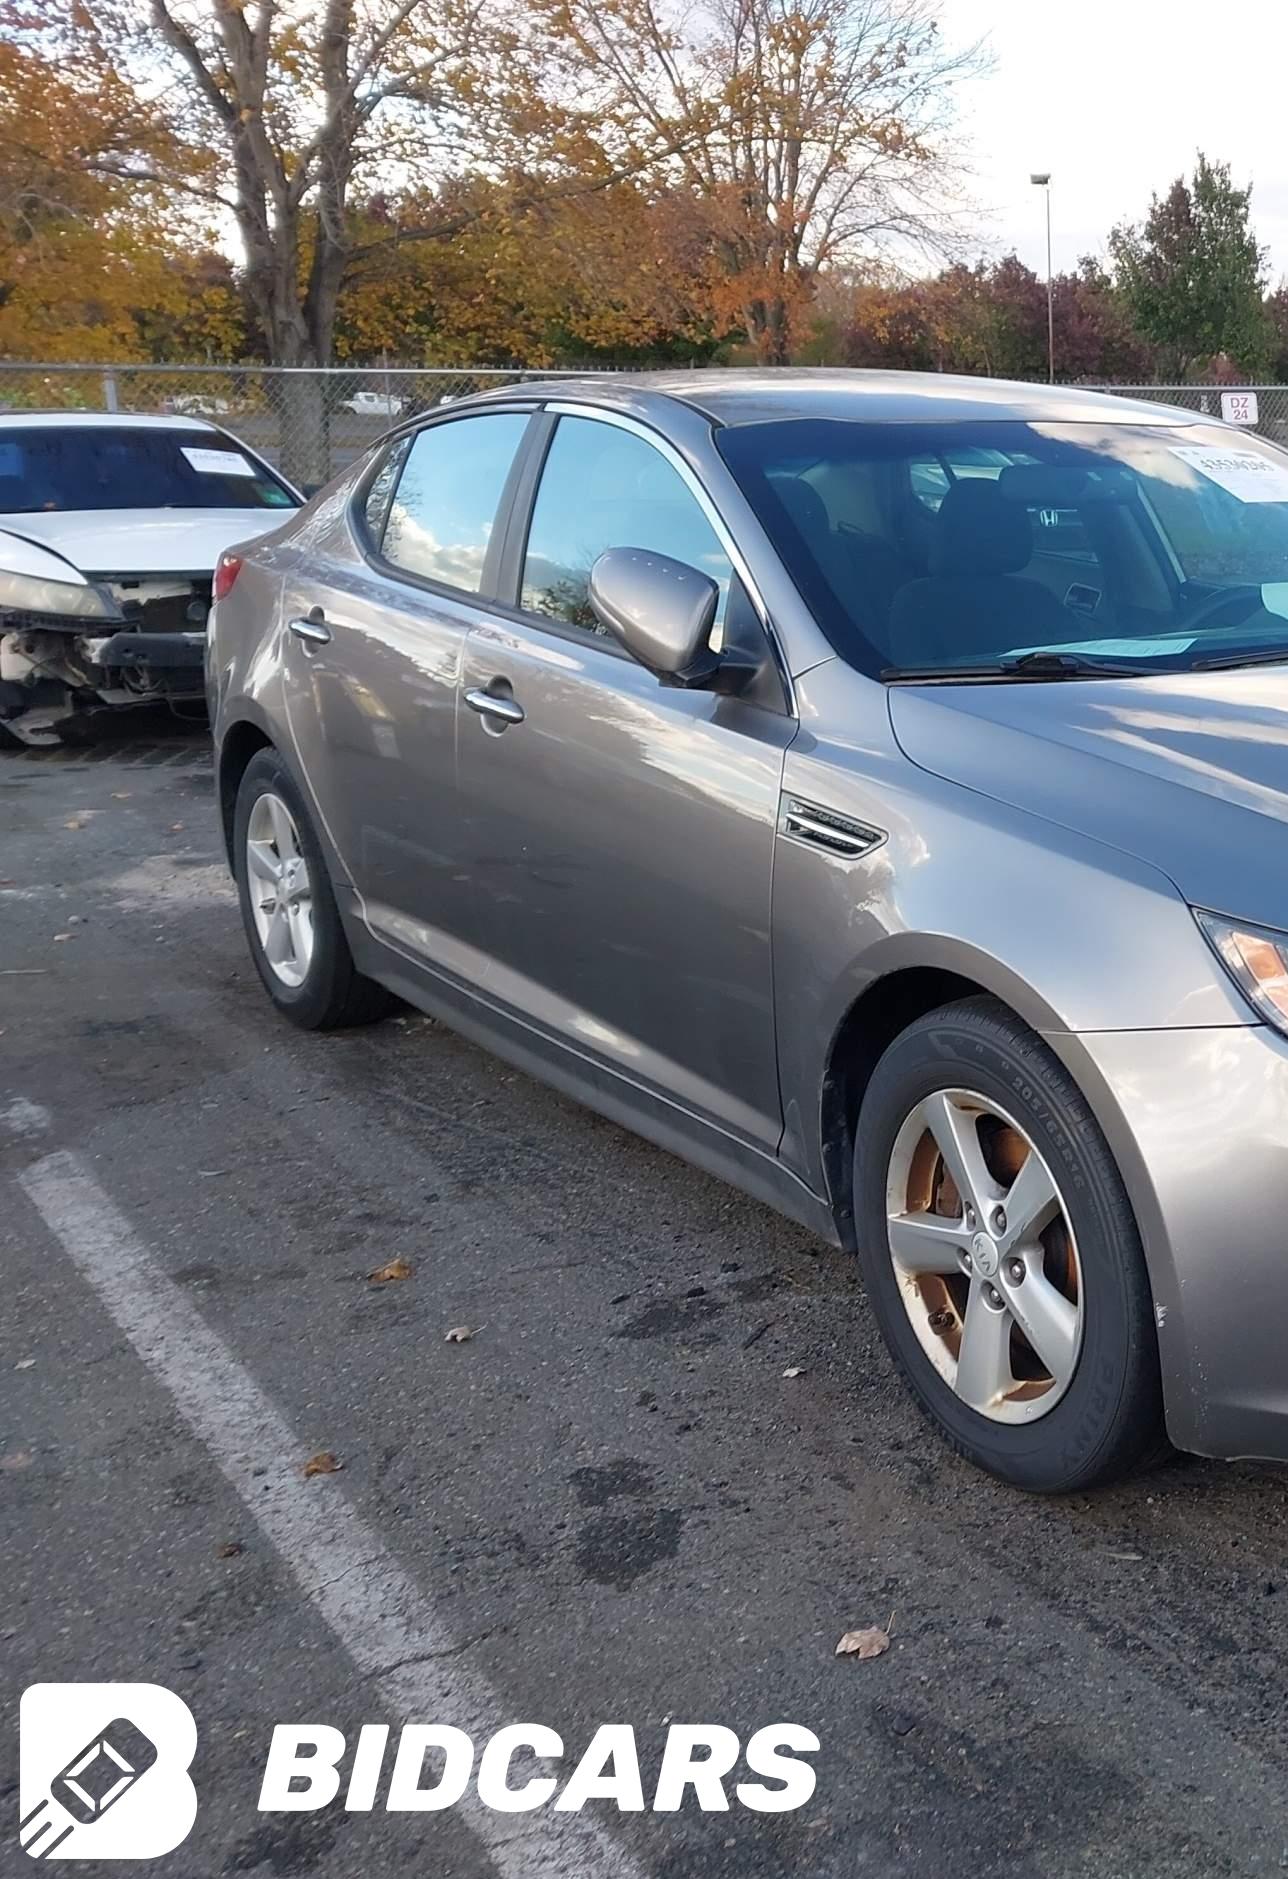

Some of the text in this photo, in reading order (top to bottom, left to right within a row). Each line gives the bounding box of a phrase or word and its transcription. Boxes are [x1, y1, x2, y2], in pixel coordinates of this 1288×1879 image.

[1230, 397, 1249, 408] DZ
[1233, 409, 1249, 420] 24
[974, 1238, 991, 1273] KIA
